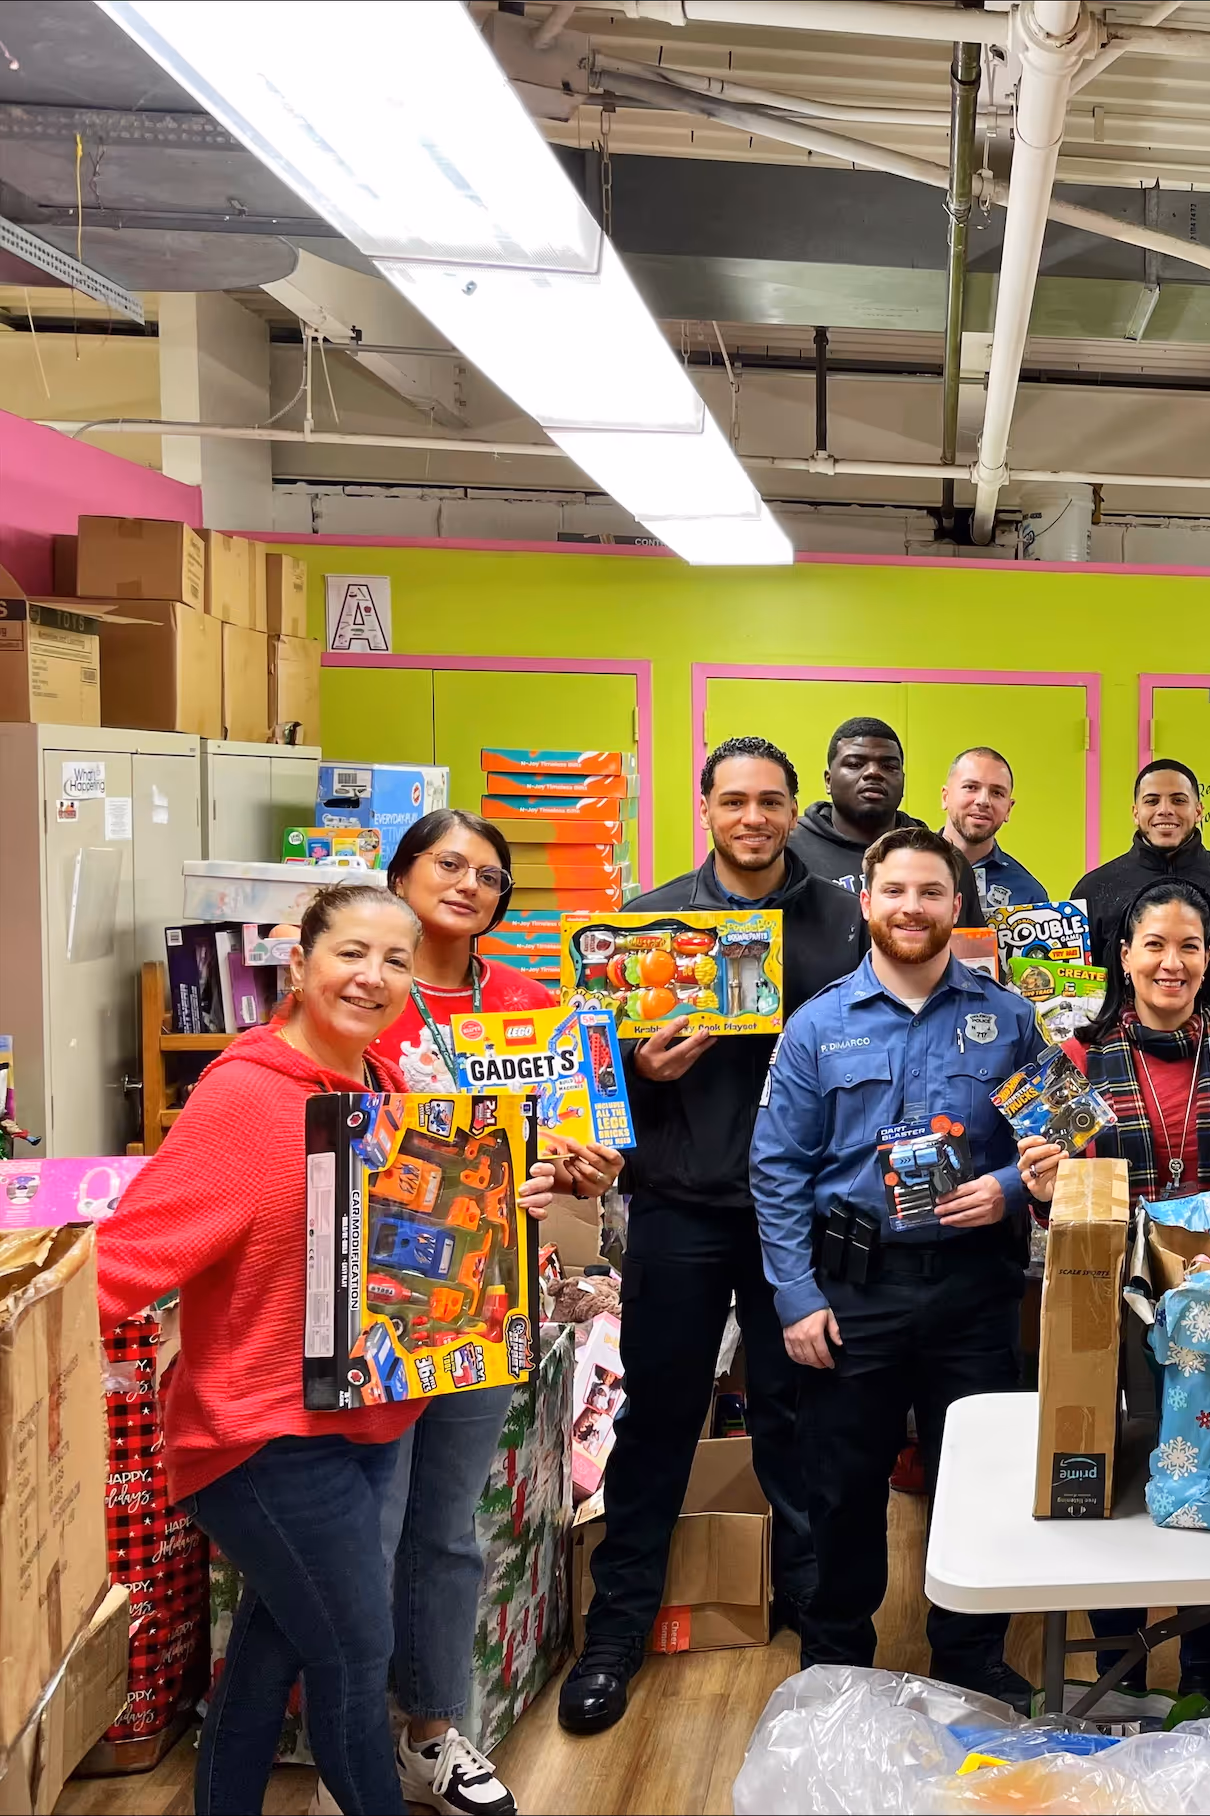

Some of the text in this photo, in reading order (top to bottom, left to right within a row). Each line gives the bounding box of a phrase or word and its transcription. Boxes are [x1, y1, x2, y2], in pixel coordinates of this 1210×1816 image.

[331, 583, 388, 651] A
[998, 915, 1084, 949] ROUBLE
[1061, 934, 1081, 943] GAME
[1057, 968, 1105, 981] CREATE
[583, 1015, 594, 1024] 58
[507, 1025, 533, 1037] LEGO
[820, 1044, 829, 1053] P.
[1005, 1087, 1039, 1118] TRUCKS
[597, 1116, 627, 1130] LEGO
[881, 1126, 907, 1135] DART
[881, 1127, 925, 1141] BLASTER
[350, 1191, 360, 1310] CAR MODIFICATION
[416, 1356, 435, 1379] 36
[474, 1345, 486, 1382] EASY!
[1060, 1469, 1097, 1483] prime
[105, 1484, 151, 1514] olidays
[164, 1516, 193, 1535] HAPP
[671, 1620, 680, 1646] Cheer
[127, 1689, 153, 1704] PPY
